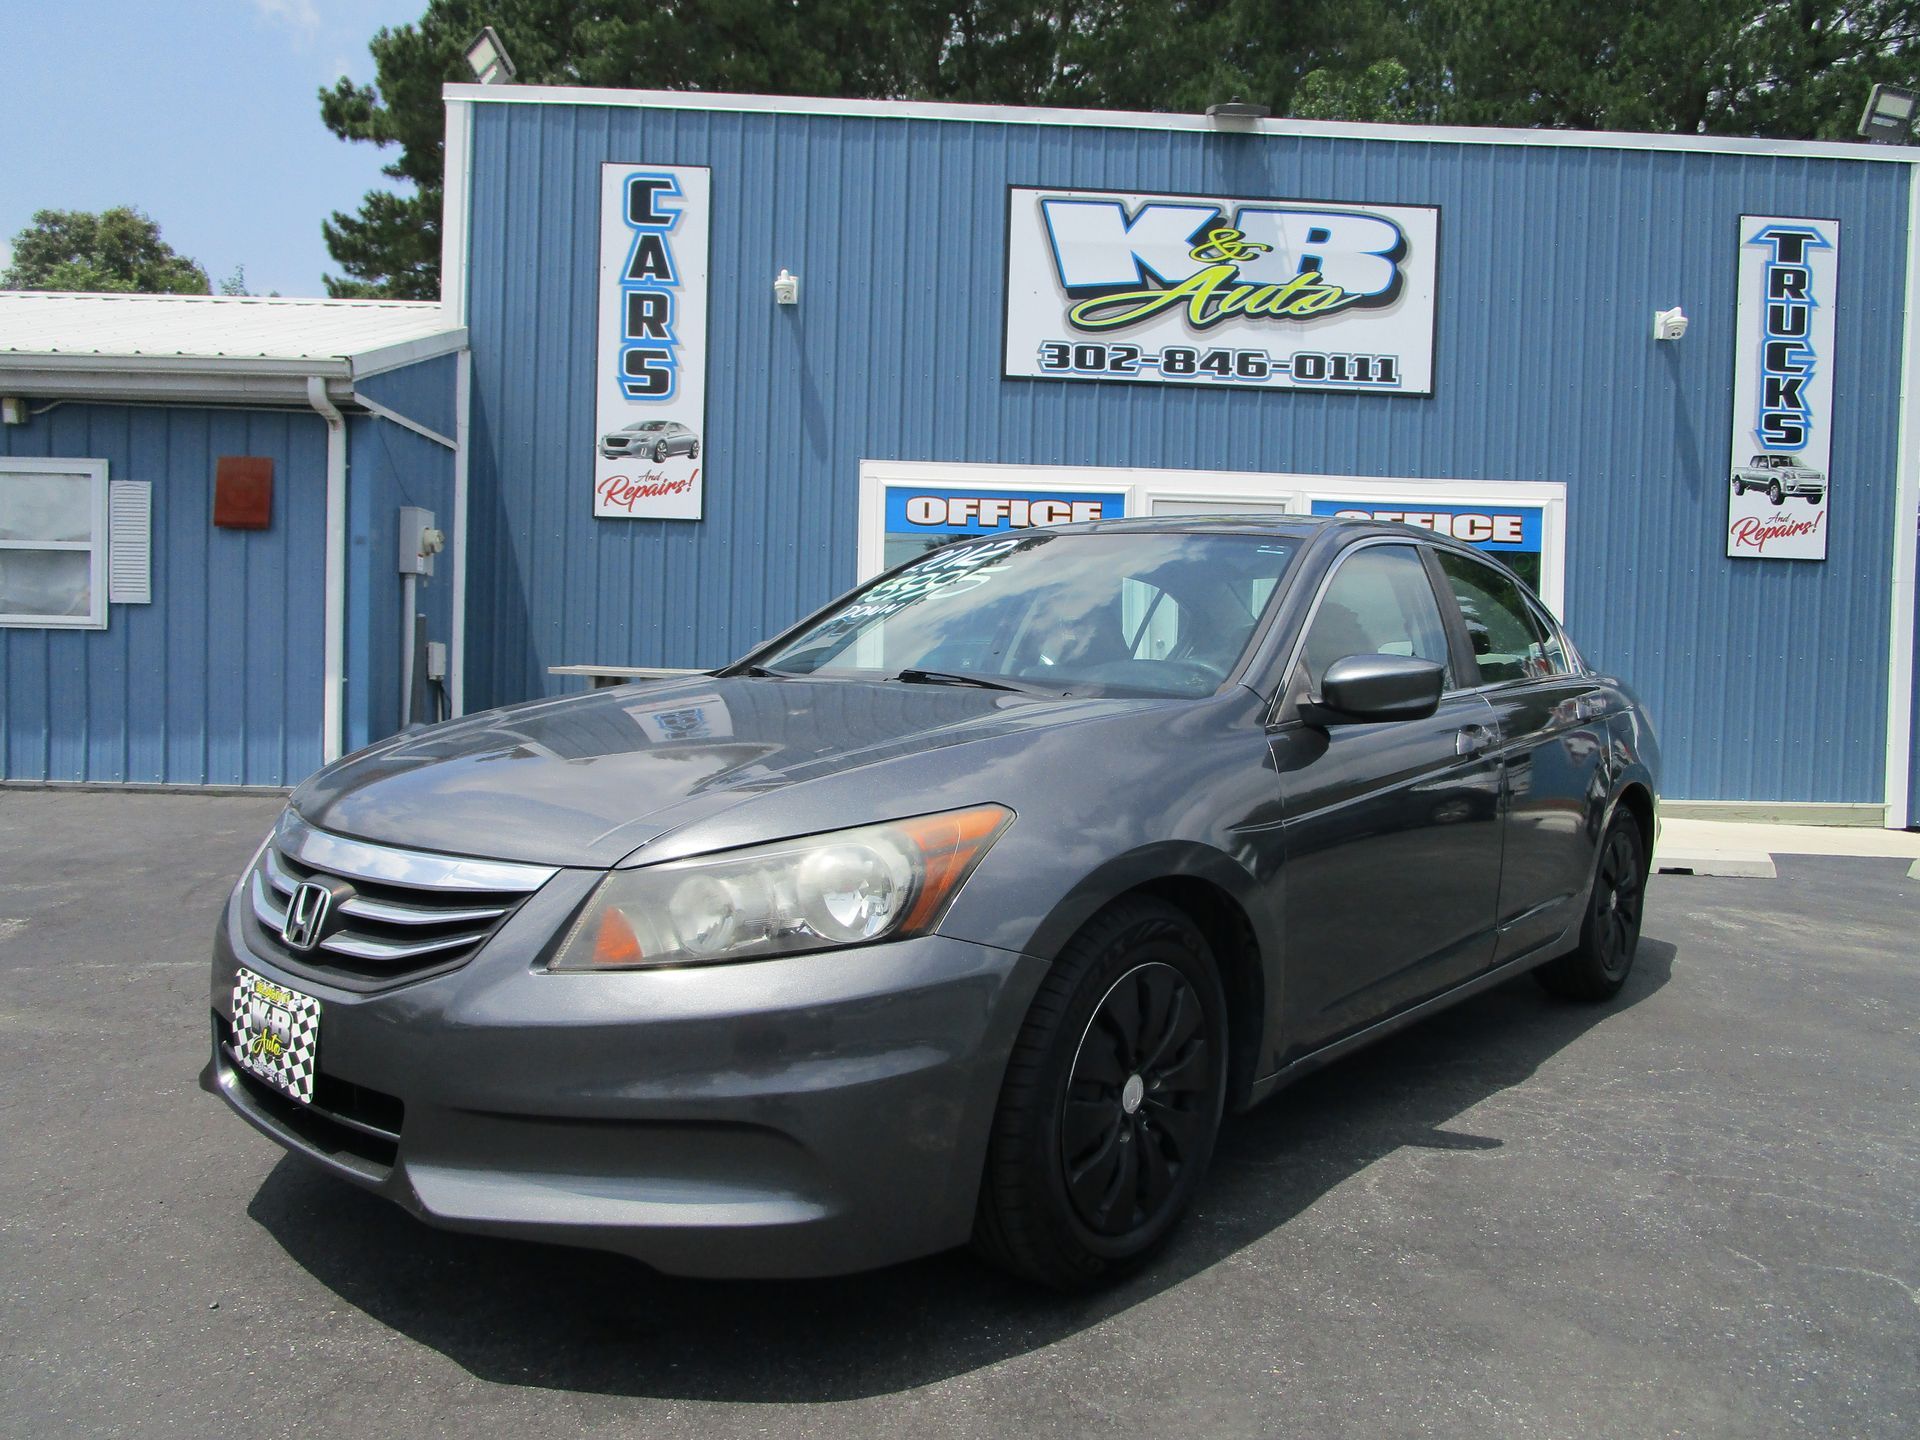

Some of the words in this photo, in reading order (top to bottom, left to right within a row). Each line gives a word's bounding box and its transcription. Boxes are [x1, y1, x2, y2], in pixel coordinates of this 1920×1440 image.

[617, 173, 683, 400] CARS
[1069, 264, 1362, 327] Auto
[1750, 225, 1832, 449] TRUCKS
[1040, 342, 1401, 387] 302-846-0111
[597, 468, 699, 512] Repairs!
[634, 469, 664, 483] And
[906, 496, 1102, 527] OFFICE
[1765, 512, 1792, 524] And
[1731, 511, 1824, 553] Repairs!
[903, 539, 1019, 573] 2012
[832, 602, 906, 621] DOWN
[252, 1027, 284, 1057] Auto
